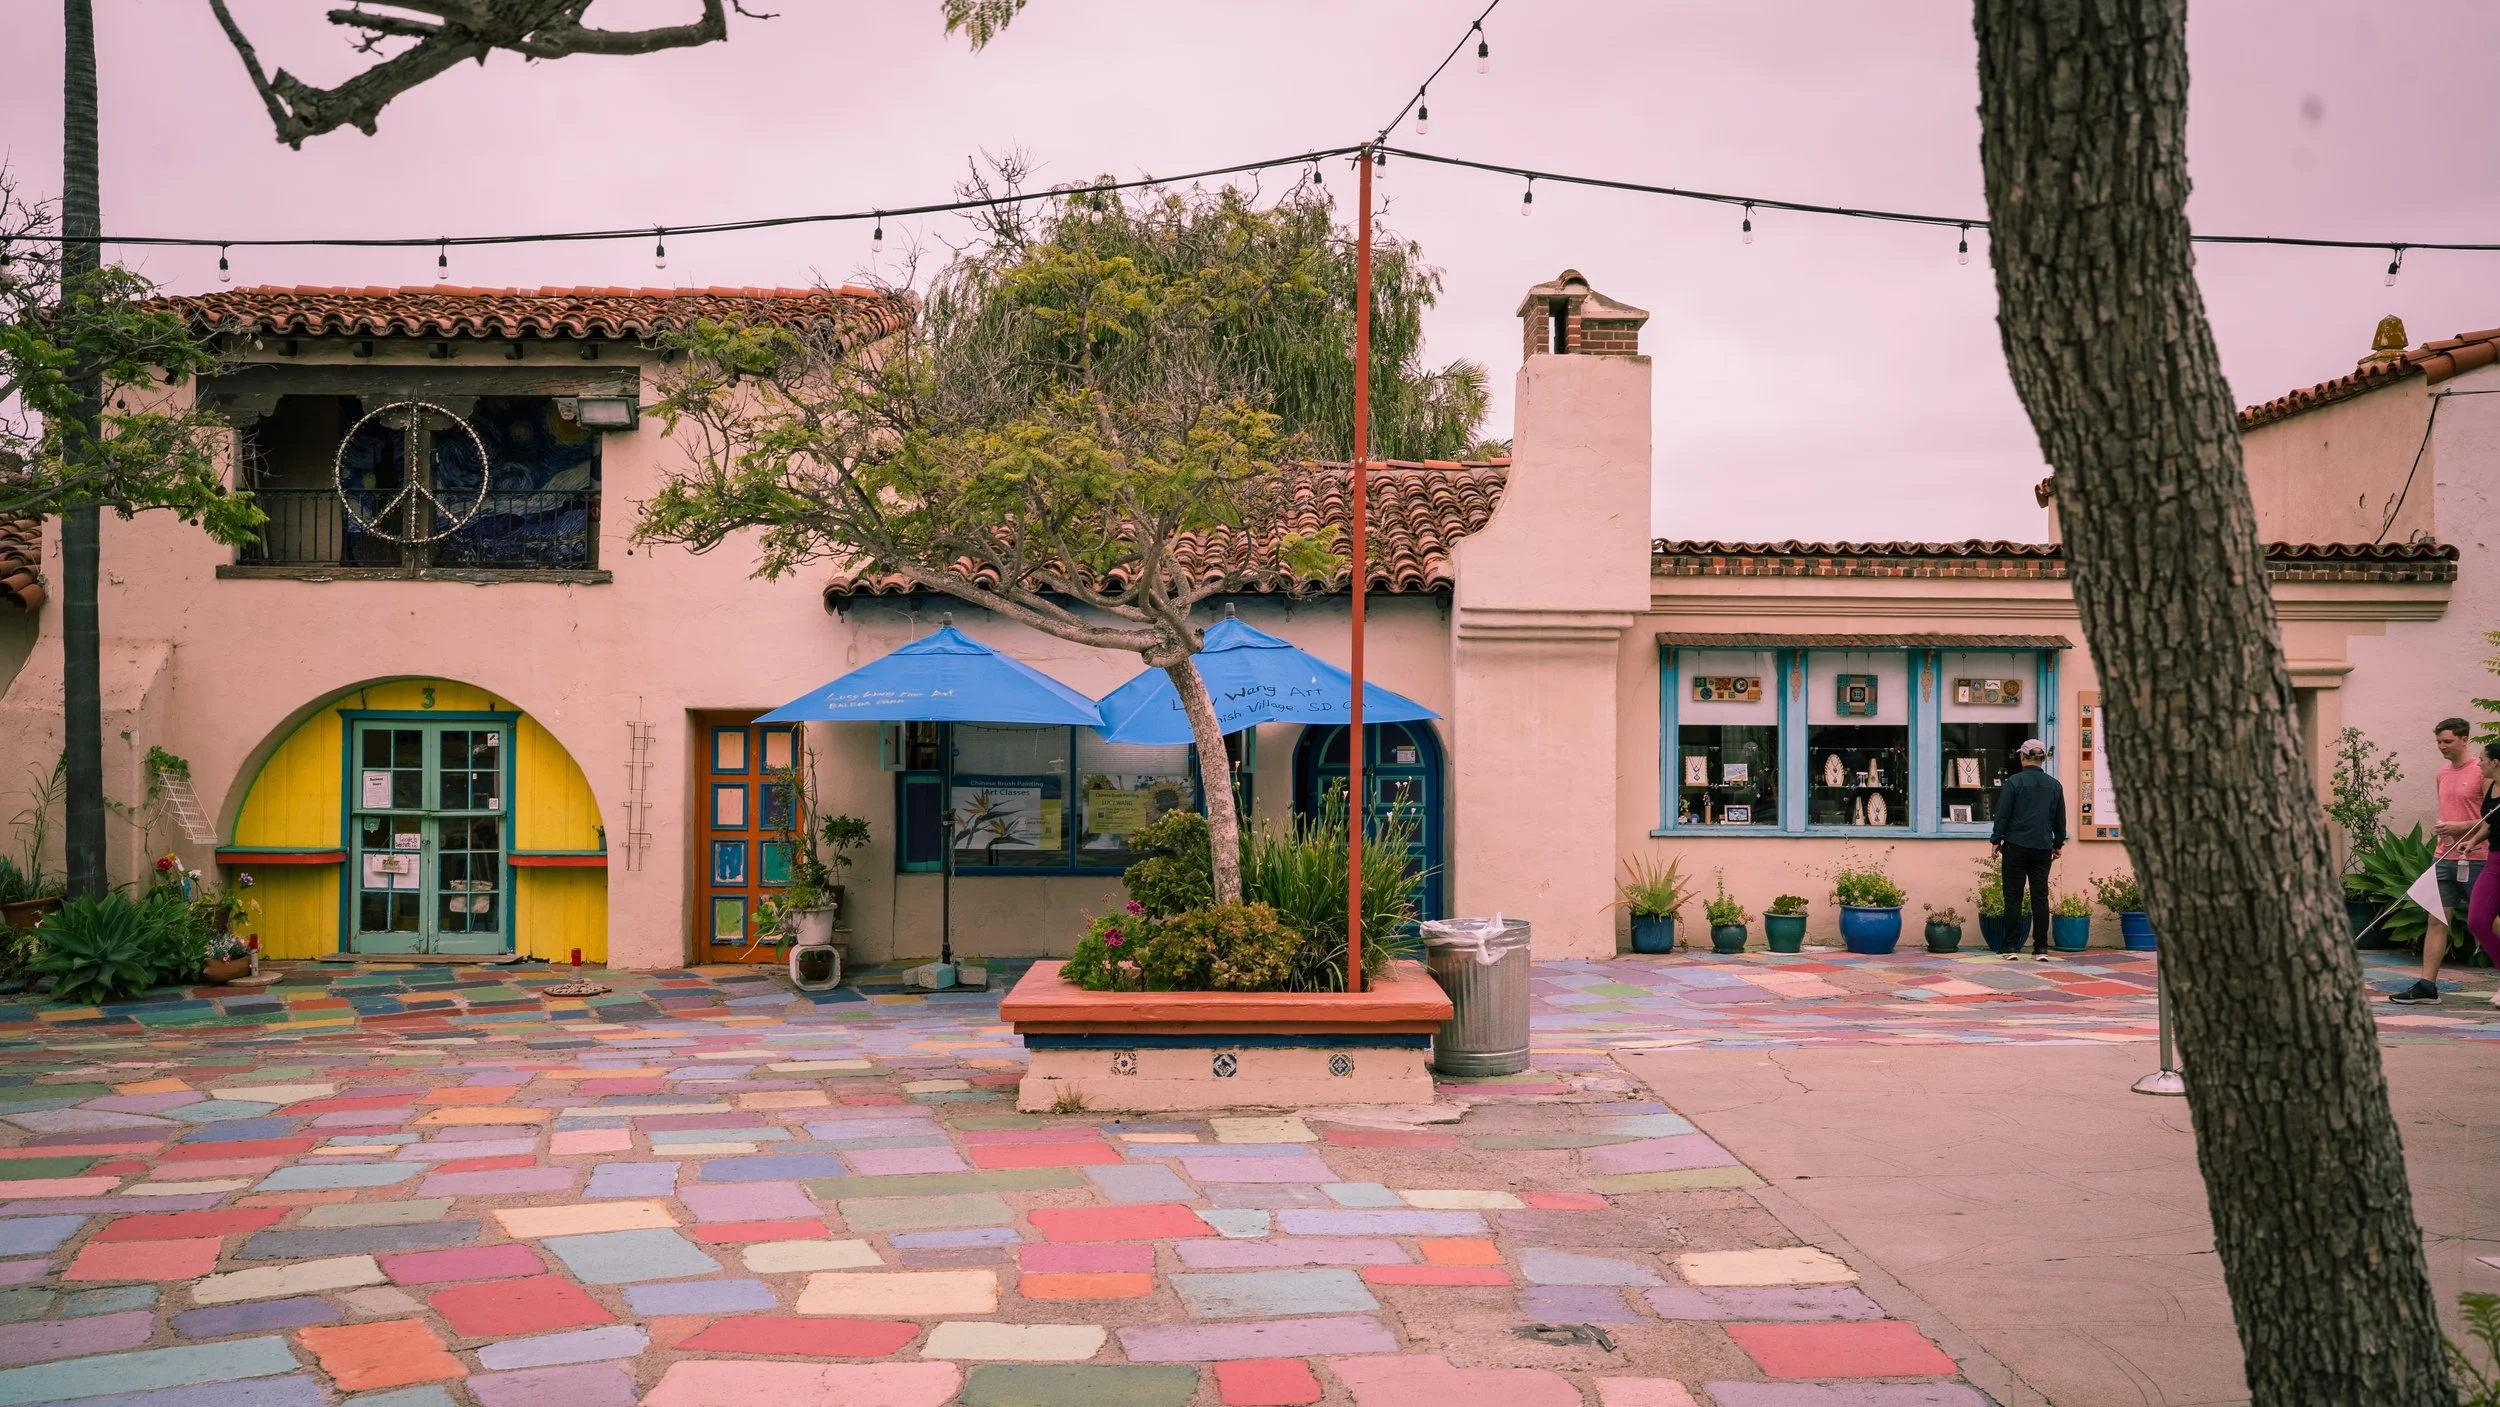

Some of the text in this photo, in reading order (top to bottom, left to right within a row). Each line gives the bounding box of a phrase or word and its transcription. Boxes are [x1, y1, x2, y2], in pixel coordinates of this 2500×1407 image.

[421, 688, 436, 709] 3
[1224, 685, 1276, 701] Wang
[1289, 686, 1323, 697] Art
